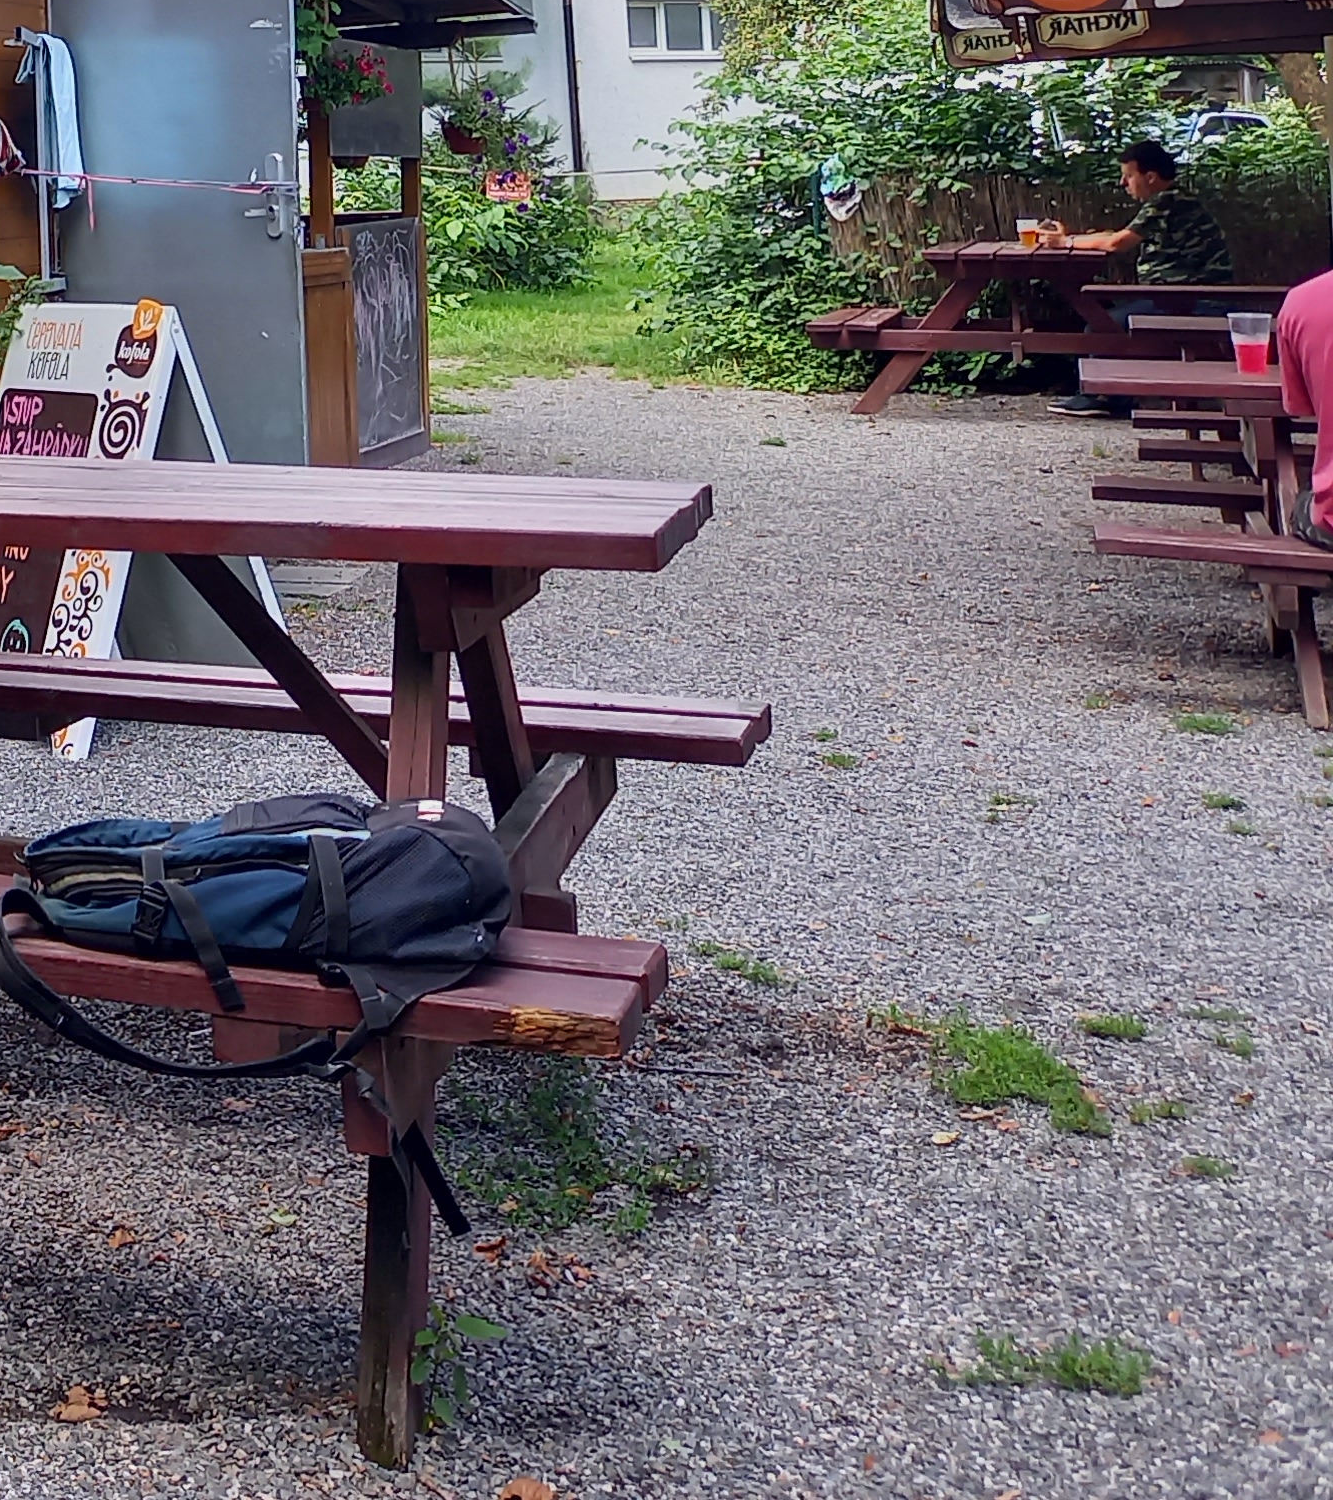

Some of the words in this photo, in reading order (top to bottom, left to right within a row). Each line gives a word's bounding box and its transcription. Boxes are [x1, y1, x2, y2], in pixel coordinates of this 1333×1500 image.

[26, 351, 71, 381] KOFOLA
[117, 340, 151, 365] kofola
[2, 394, 44, 427] VSTUP
